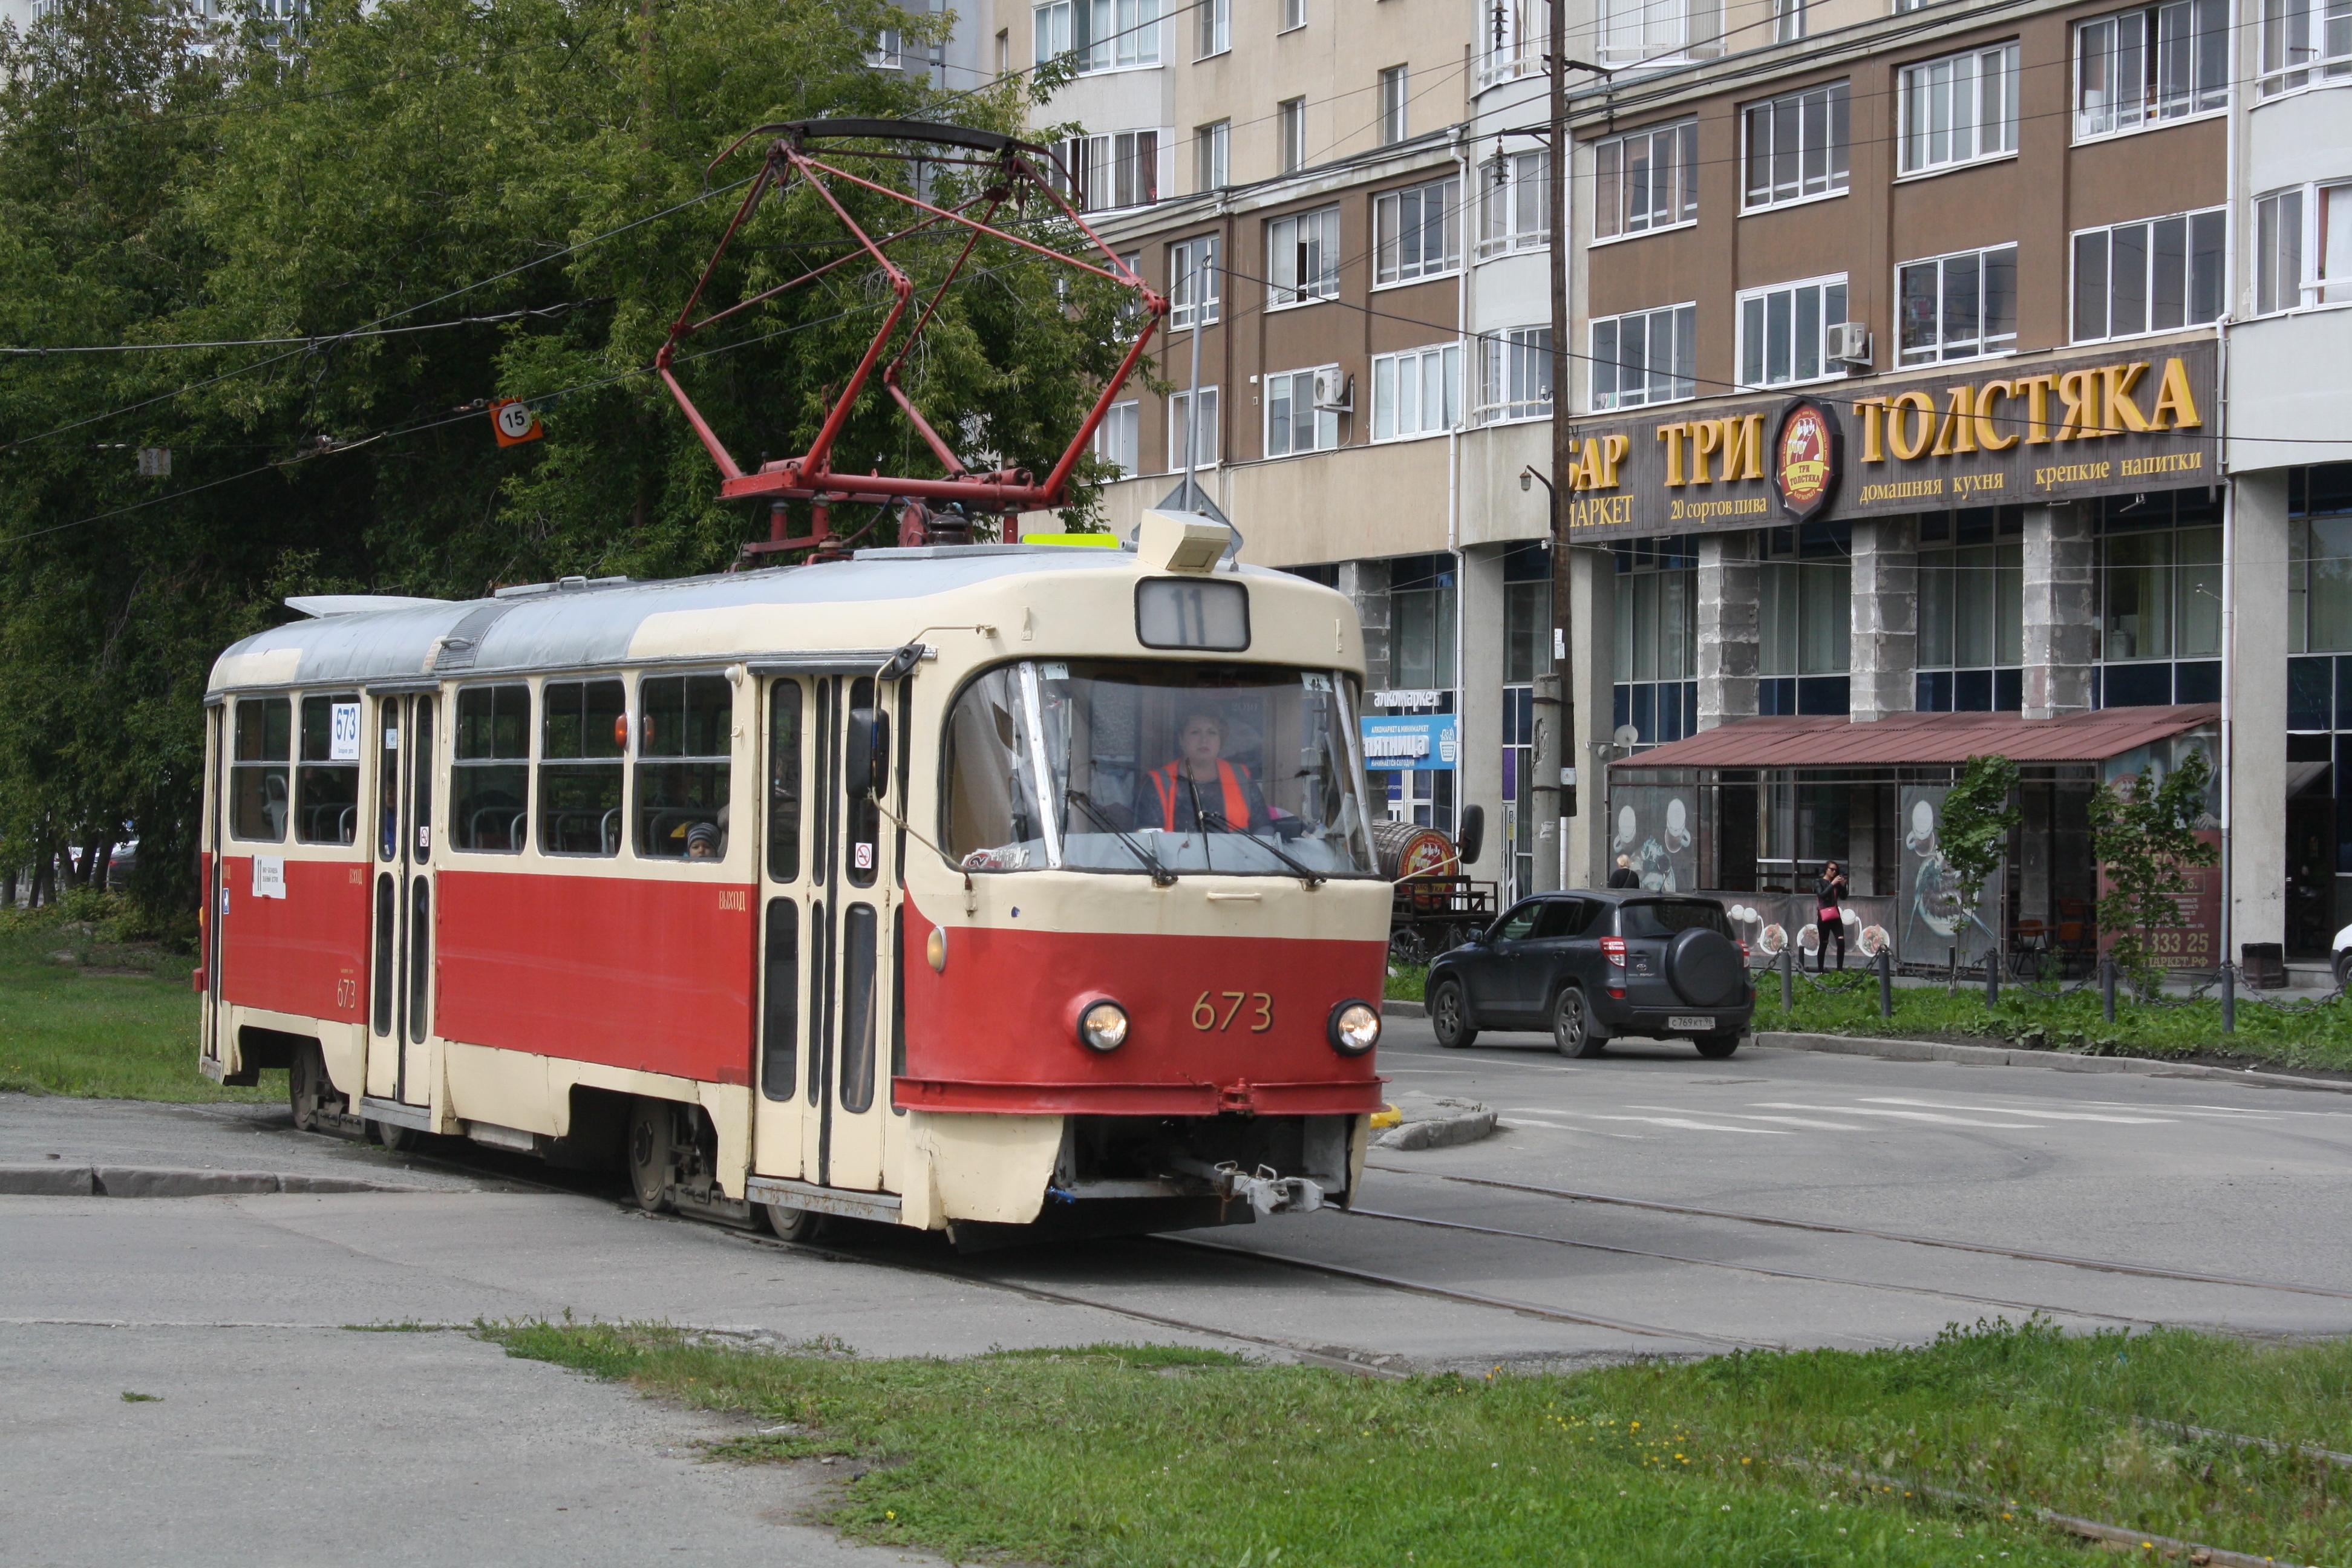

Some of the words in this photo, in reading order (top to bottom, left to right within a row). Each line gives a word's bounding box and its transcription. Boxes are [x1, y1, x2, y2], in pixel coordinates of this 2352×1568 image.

[505, 410, 525, 428] 15
[1657, 414, 1765, 487] ТРИ
[1853, 358, 2202, 463] ТОЛСТЯКА
[1790, 474, 1820, 486] ТОЛСТЯКА
[2034, 460, 2111, 491] крепкие
[2120, 452, 2203, 477] напитки
[1859, 478, 1943, 506] домашняя
[1953, 472, 2004, 500] кухня
[1670, 500, 1685, 521] 20
[1687, 500, 1733, 524] сортов
[1734, 497, 1767, 515] пива
[1171, 587, 1205, 645] 11
[1374, 691, 1443, 712] алкомаркет
[336, 707, 356, 741] 673
[1364, 734, 1429, 758] пятница
[719, 890, 745, 912] ВЫХОД
[2187, 933, 2209, 953] 25
[338, 978, 355, 1008] 673
[1192, 991, 1272, 1030] 673
